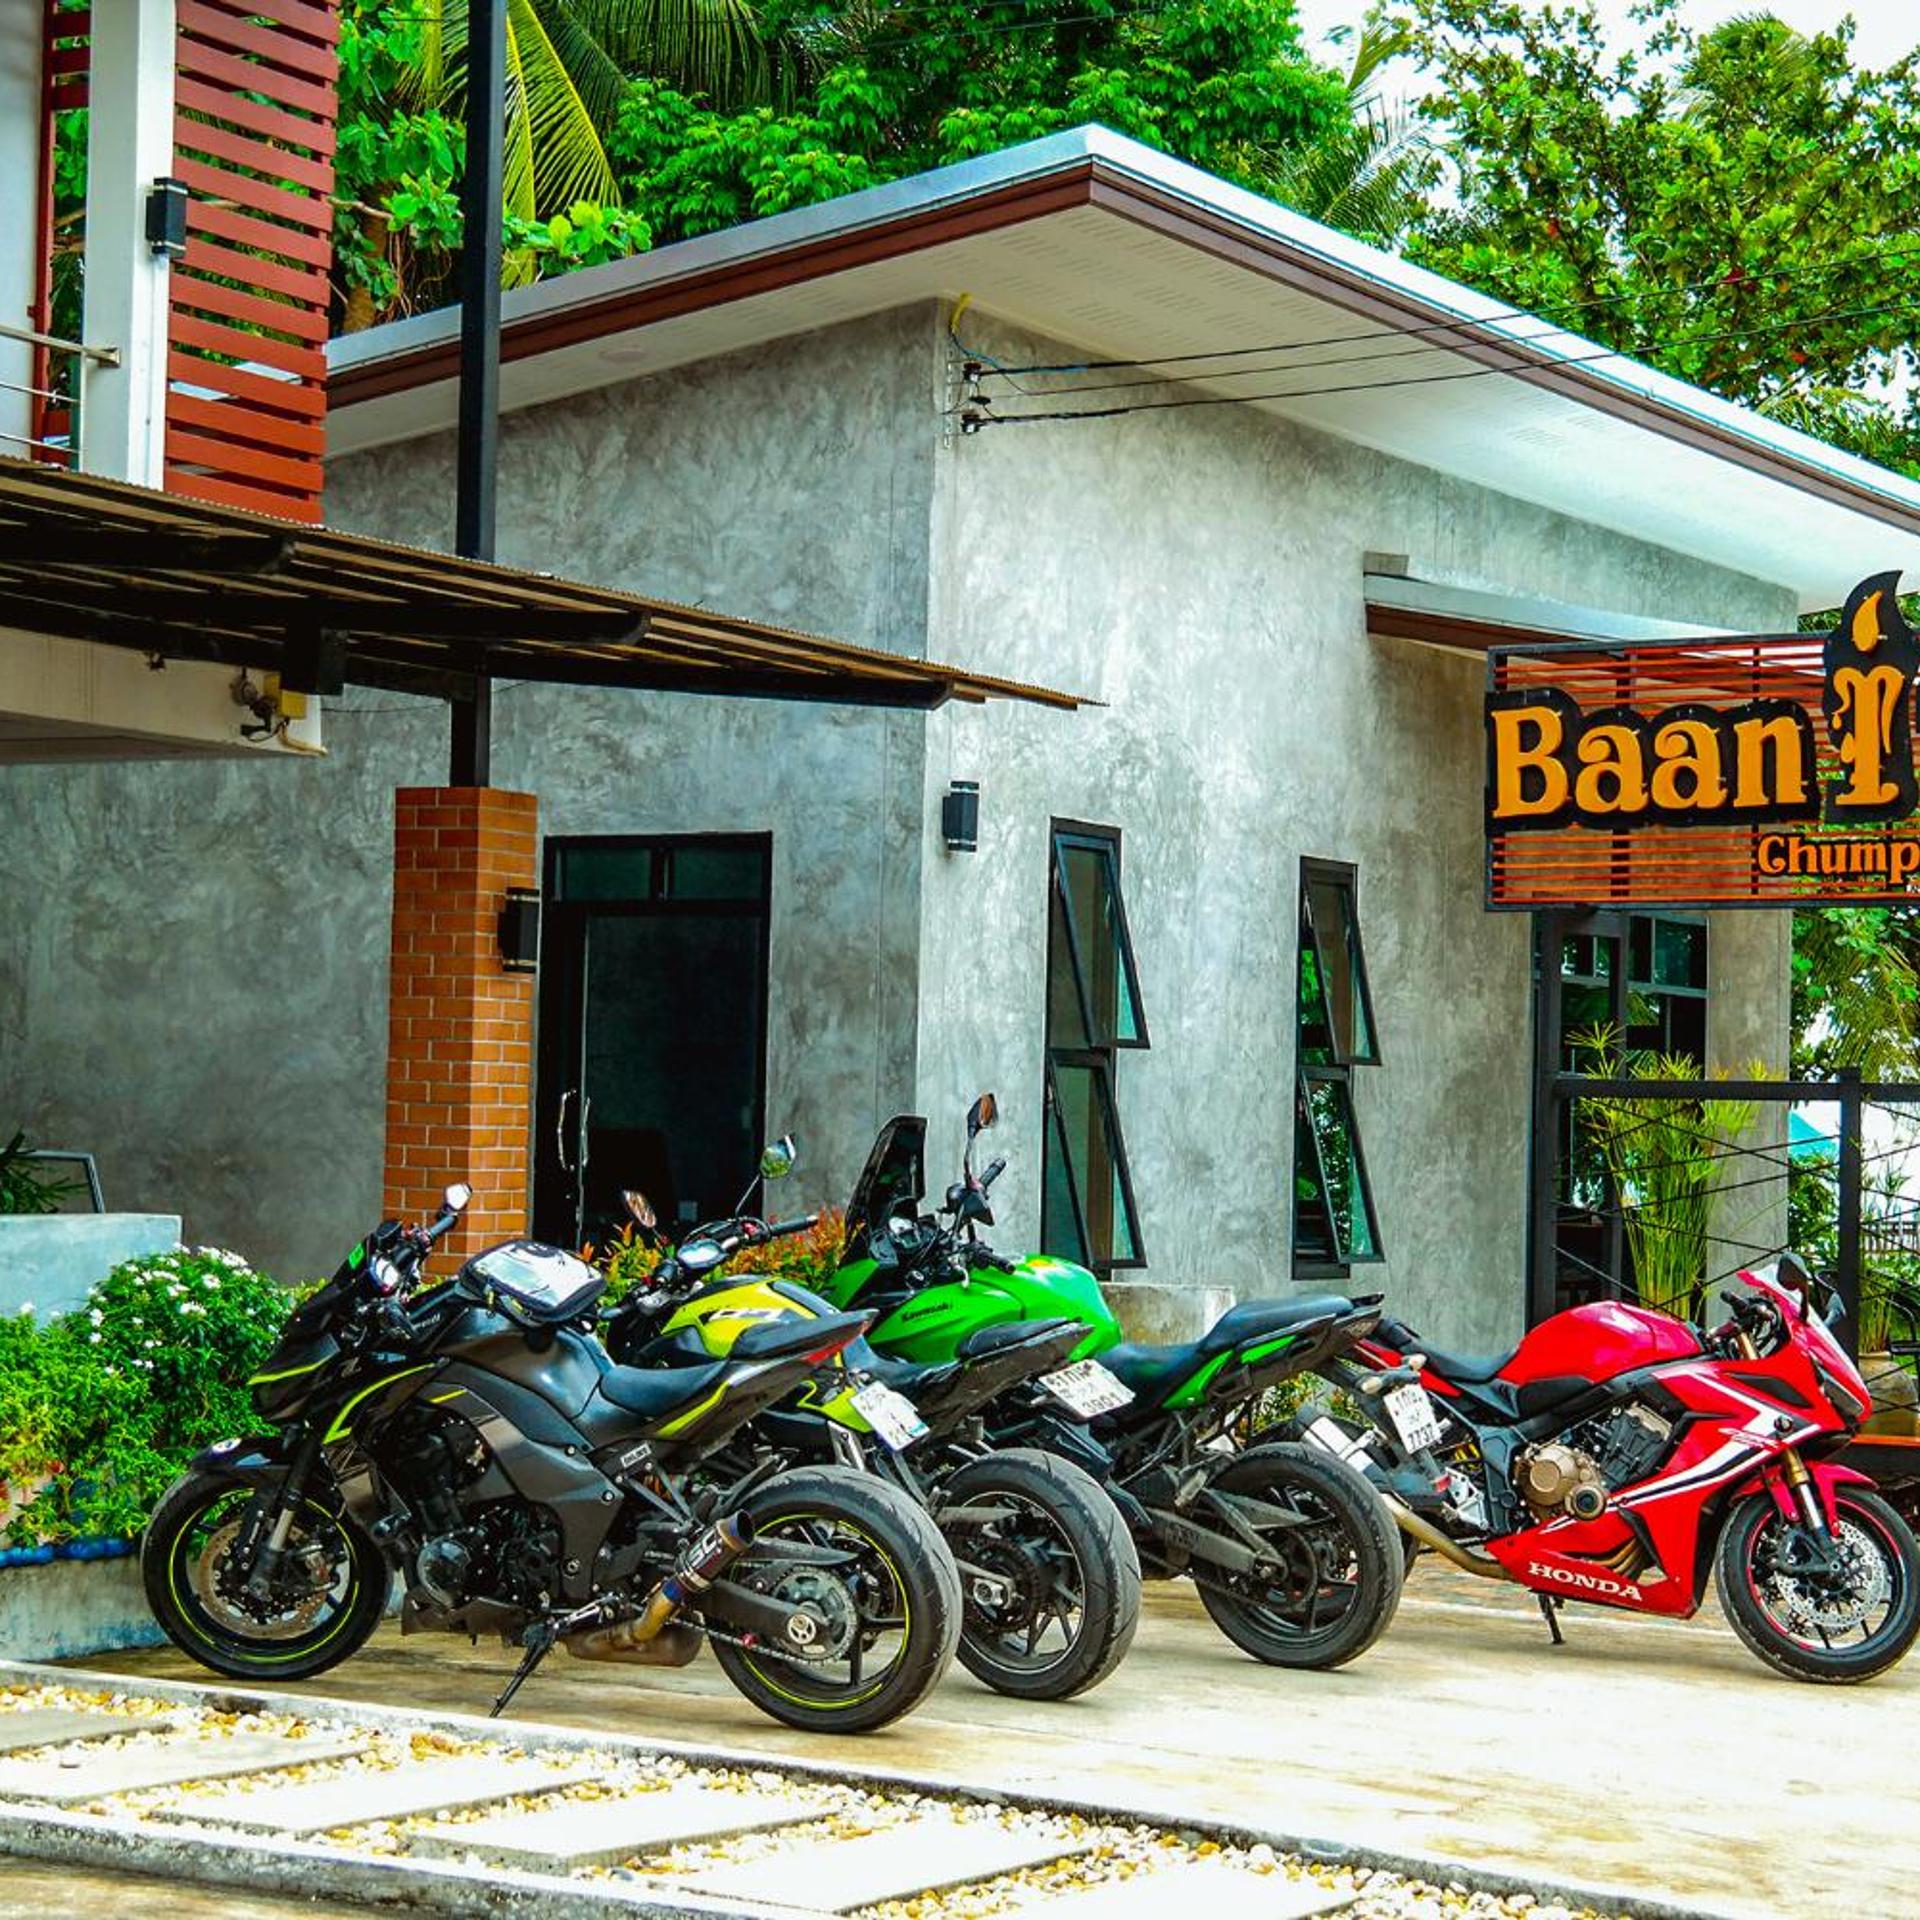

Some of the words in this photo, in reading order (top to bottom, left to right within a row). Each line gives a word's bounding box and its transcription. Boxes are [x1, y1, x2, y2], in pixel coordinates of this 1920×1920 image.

[1491, 705, 1808, 818] Baan
[1758, 834, 1920, 885] Chump
[1528, 1561, 1642, 1601] HONDA
